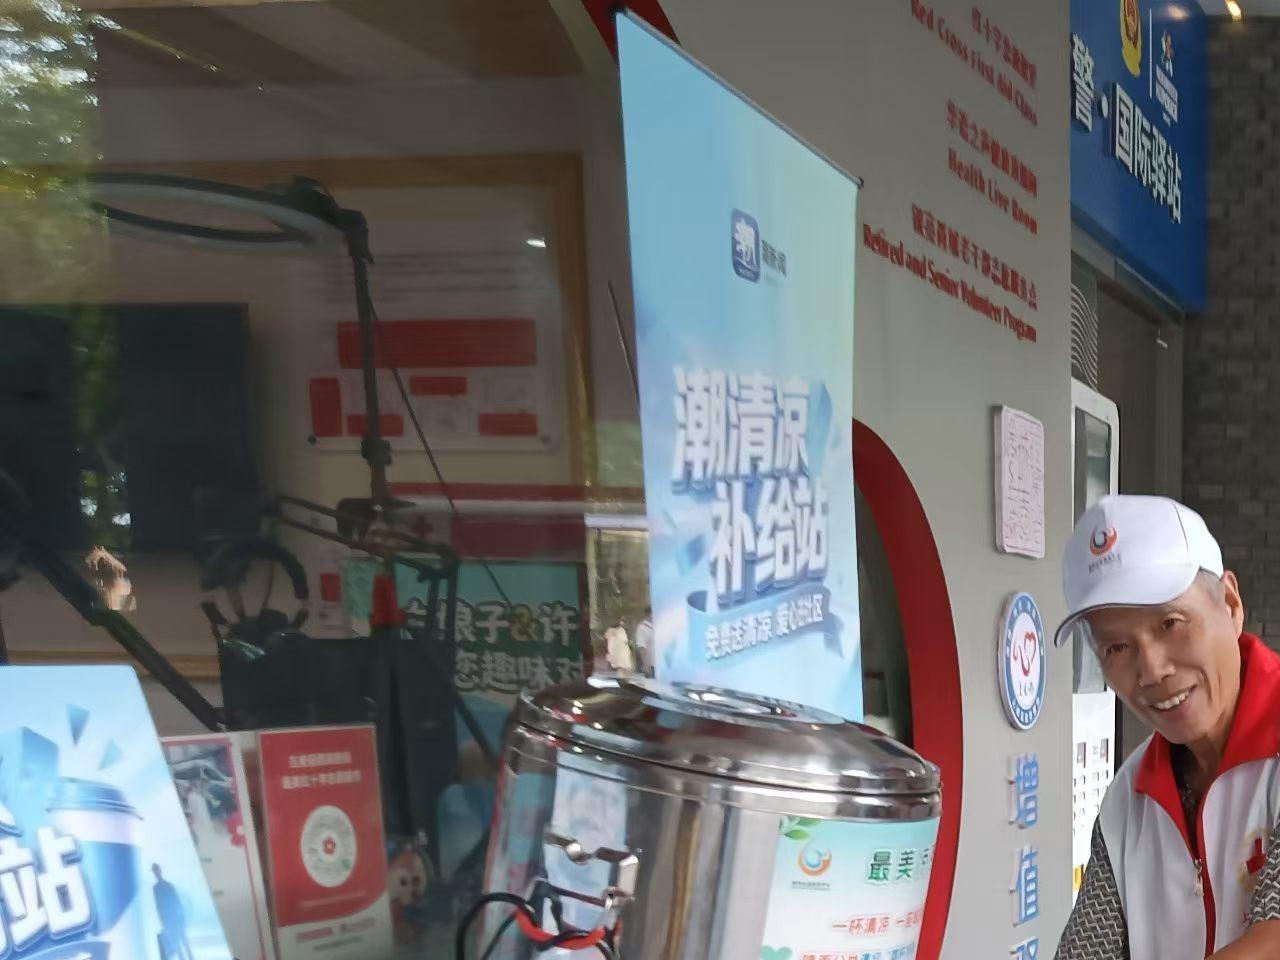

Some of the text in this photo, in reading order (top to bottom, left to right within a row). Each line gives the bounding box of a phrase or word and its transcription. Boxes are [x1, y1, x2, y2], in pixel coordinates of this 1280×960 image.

[937, 17, 968, 62] Cross
[971, 49, 995, 86] First
[997, 71, 1013, 101] Aid
[948, 147, 1038, 235] Health Live Room
[863, 223, 1037, 342] Retired and Senior Volunteer Program
[672, 366, 810, 485] 潮清凉
[710, 475, 829, 602] 补给站
[705, 610, 773, 660] 免费送清凉
[0, 826, 93, 956] 站
